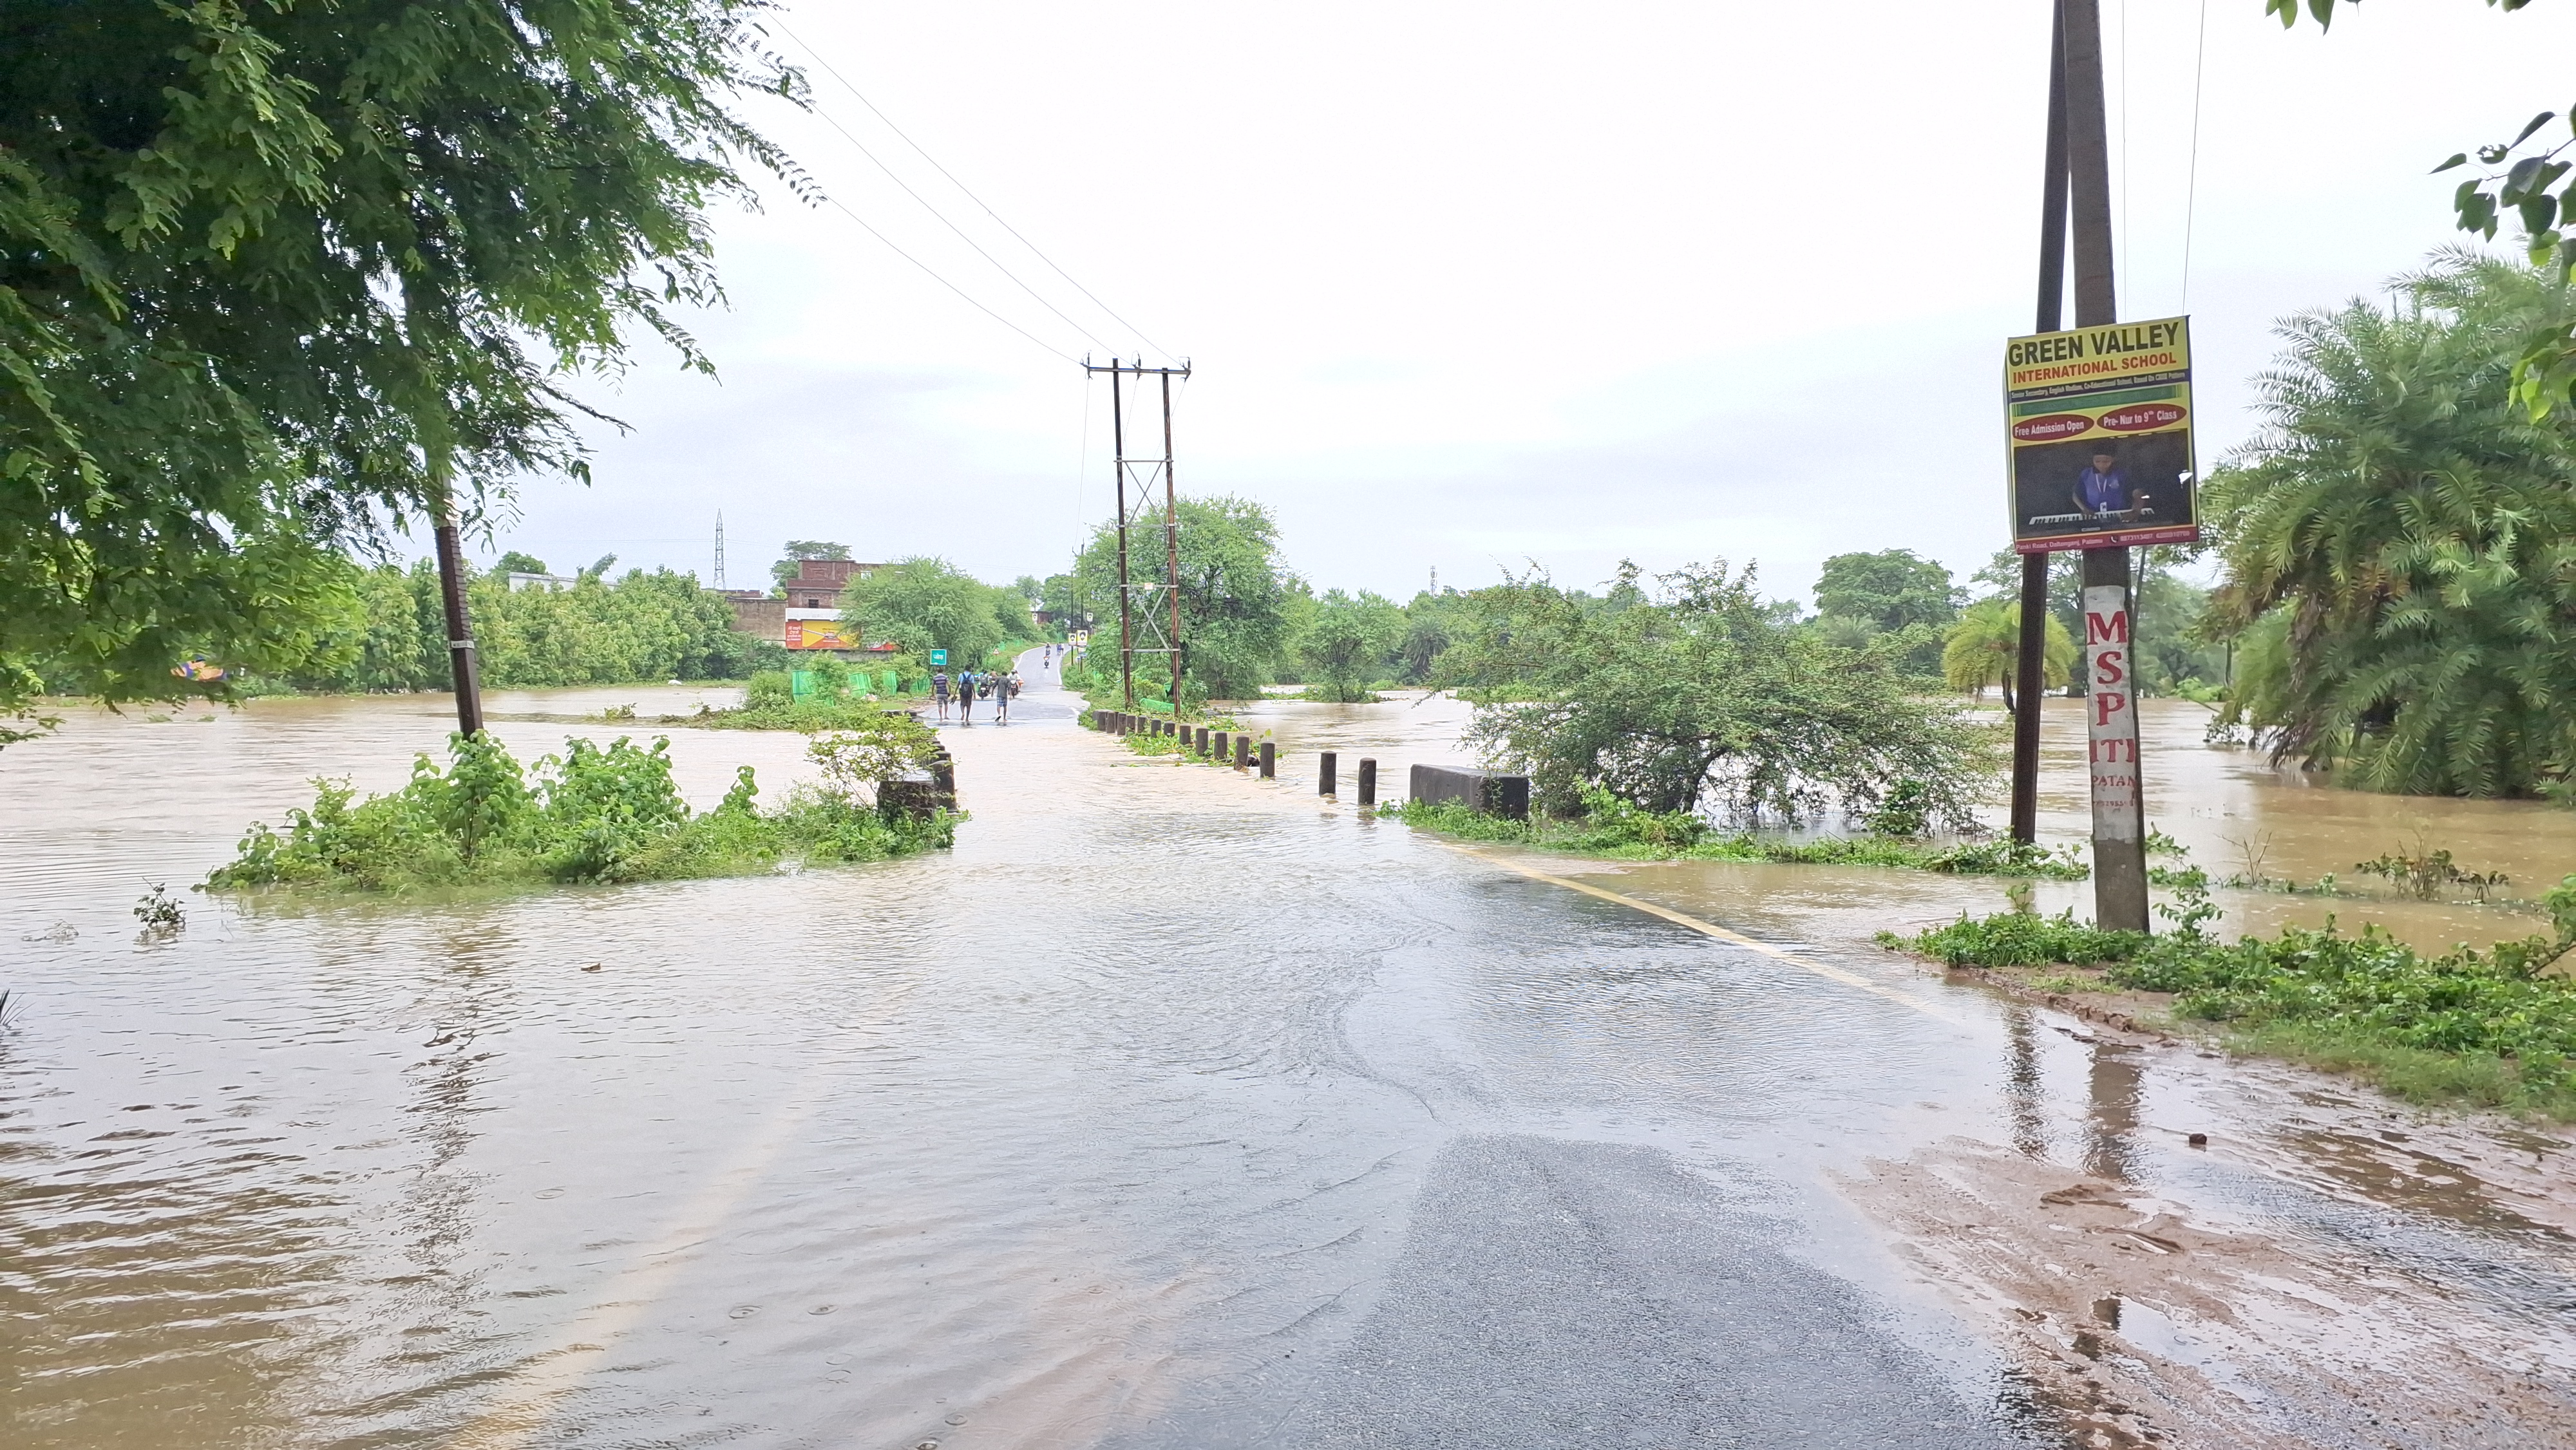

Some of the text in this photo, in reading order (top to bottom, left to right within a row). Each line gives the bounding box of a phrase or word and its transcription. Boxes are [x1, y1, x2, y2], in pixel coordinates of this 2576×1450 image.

[2009, 322, 2179, 367] GREEN VALLEY
[2013, 359, 2117, 384] INTERNATIONAL
[2121, 352, 2177, 370] SCHOOL
[2119, 415, 2134, 425] Nur
[2134, 413, 2143, 424] to
[2157, 410, 2177, 421] Class
[2014, 420, 2085, 437] Free Admission Open
[2088, 738, 2136, 763] ITI
[2091, 775, 2137, 787] PATAN
